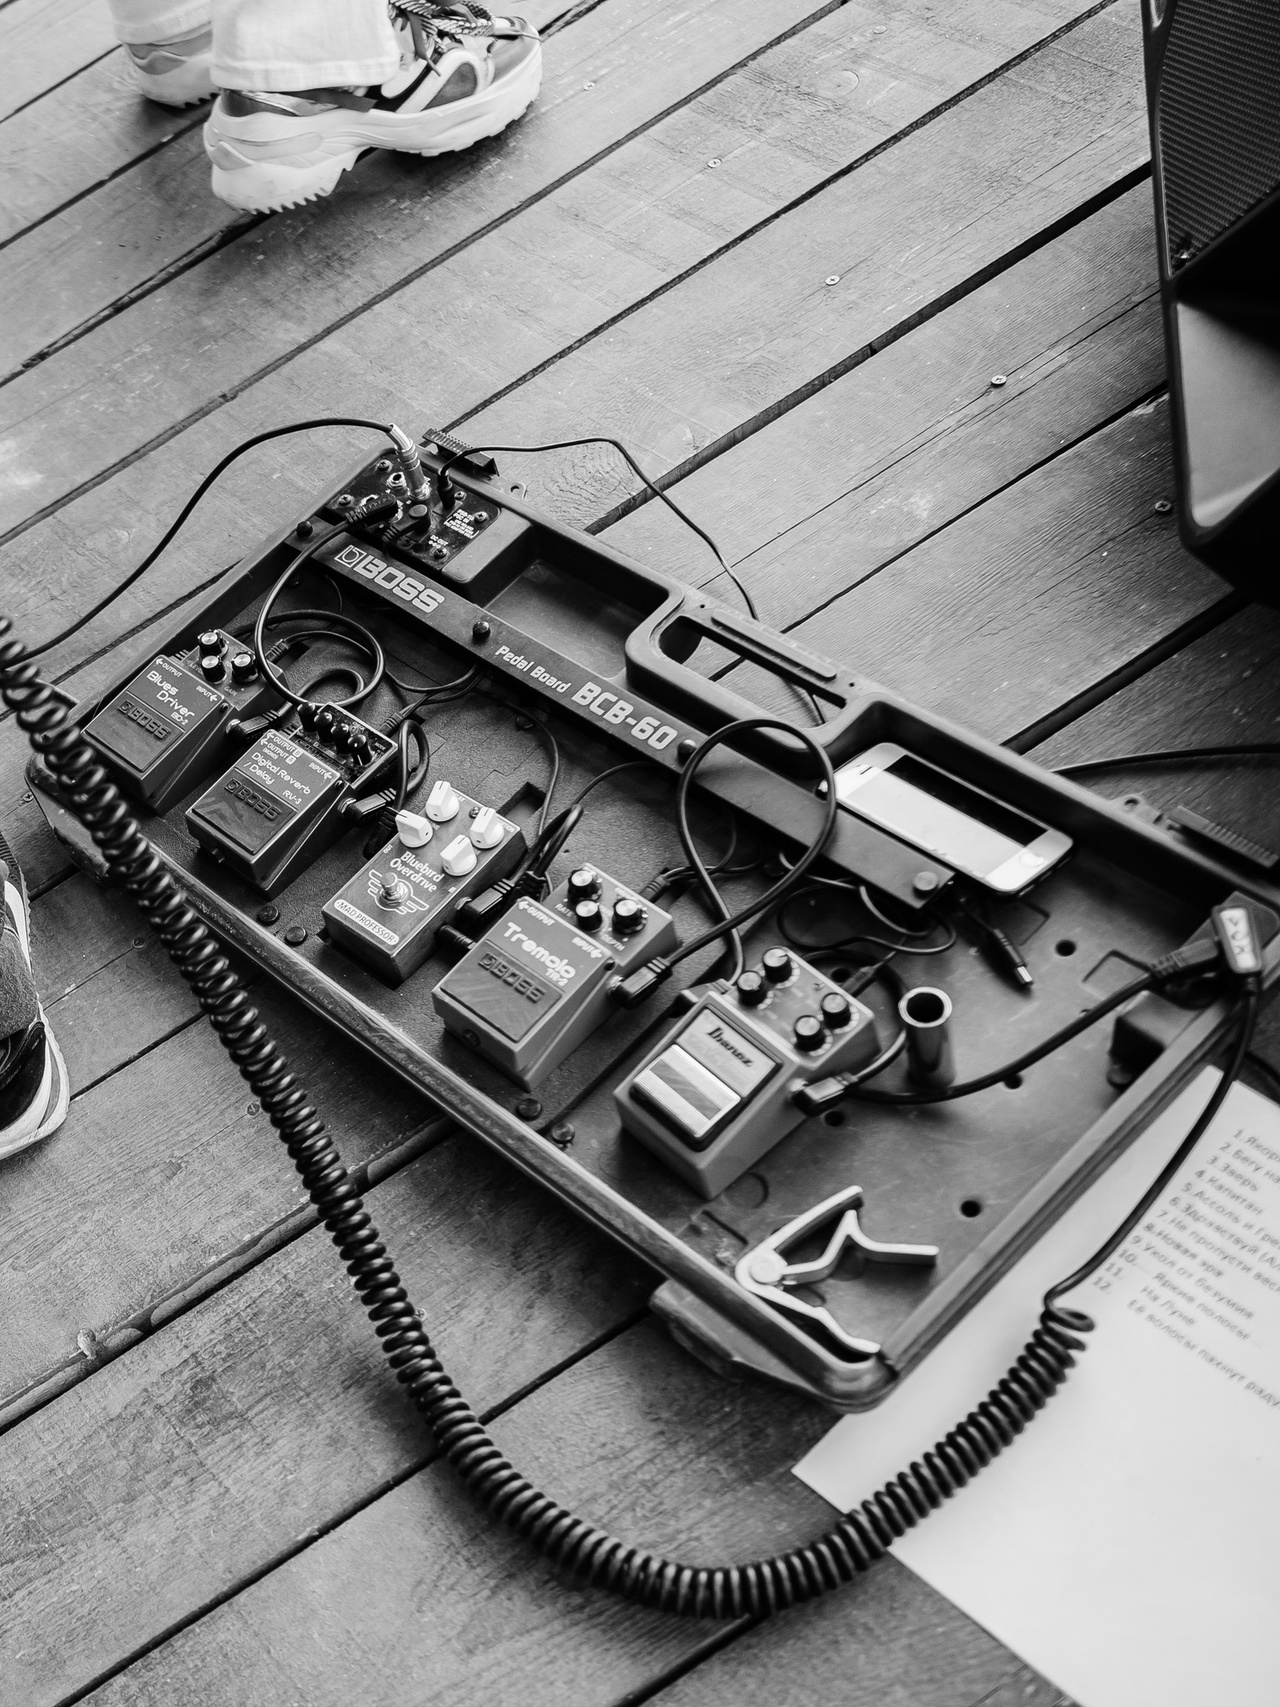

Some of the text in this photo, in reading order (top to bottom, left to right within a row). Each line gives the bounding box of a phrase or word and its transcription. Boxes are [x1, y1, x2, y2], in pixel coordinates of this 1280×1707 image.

[353, 555, 445, 612] BOSS
[146, 670, 178, 695] Blues
[161, 663, 182, 676] OUTPUT
[156, 690, 195, 717] Driver
[195, 685, 212, 696] INPUT
[495, 645, 678, 751] Pedal Board BCB-60
[127, 706, 170, 738] BOSS
[170, 712, 188, 725] BD-2
[266, 743, 288, 759] OUTPUT
[272, 737, 295, 752] OUTPUT
[249, 764, 275, 784] Delay
[251, 752, 279, 772] Digital
[277, 770, 310, 794] Reverb
[308, 763, 325, 774] INPUT
[234, 785, 281, 820] BOSS
[282, 790, 302, 804] RV-3
[389, 857, 437, 892] Overdrive
[400, 850, 444, 882] Bluebird
[337, 902, 394, 941] MAD PROFESSOR
[526, 906, 555, 926] OUTPUT
[554, 903, 573, 917] RATE
[503, 921, 575, 978] Tremolo
[571, 936, 594, 952] INPUT
[545, 968, 568, 986] TR-2
[705, 1026, 754, 1067] Ibanez
[1231, 1148, 1263, 1171] Бегу
[1219, 1162, 1258, 1192] Зверь
[1206, 1175, 1264, 1216] Капитан
[1180, 1203, 1260, 1254] Здравствуй
[1192, 1191, 1240, 1224] Ассоль
[1242, 1222, 1253, 1230] и
[1254, 1227, 1280, 1251] Гре
[1154, 1229, 1198, 1261] Новая
[1199, 1260, 1224, 1279] эра
[1167, 1217, 1187, 1233] Не
[1188, 1230, 1252, 1273] пропусти
[1104, 1260, 1197, 1327] 11. На Луне
[1117, 1247, 1252, 1341] 10. Яркие полосы
[1142, 1242, 1177, 1268] Укол
[1175, 1266, 1193, 1280] от
[1193, 1276, 1255, 1320] безумия
[1091, 1274, 1113, 1295] 12.
[1144, 1312, 1199, 1351] волосы
[1195, 1347, 1246, 1382] пахнут
